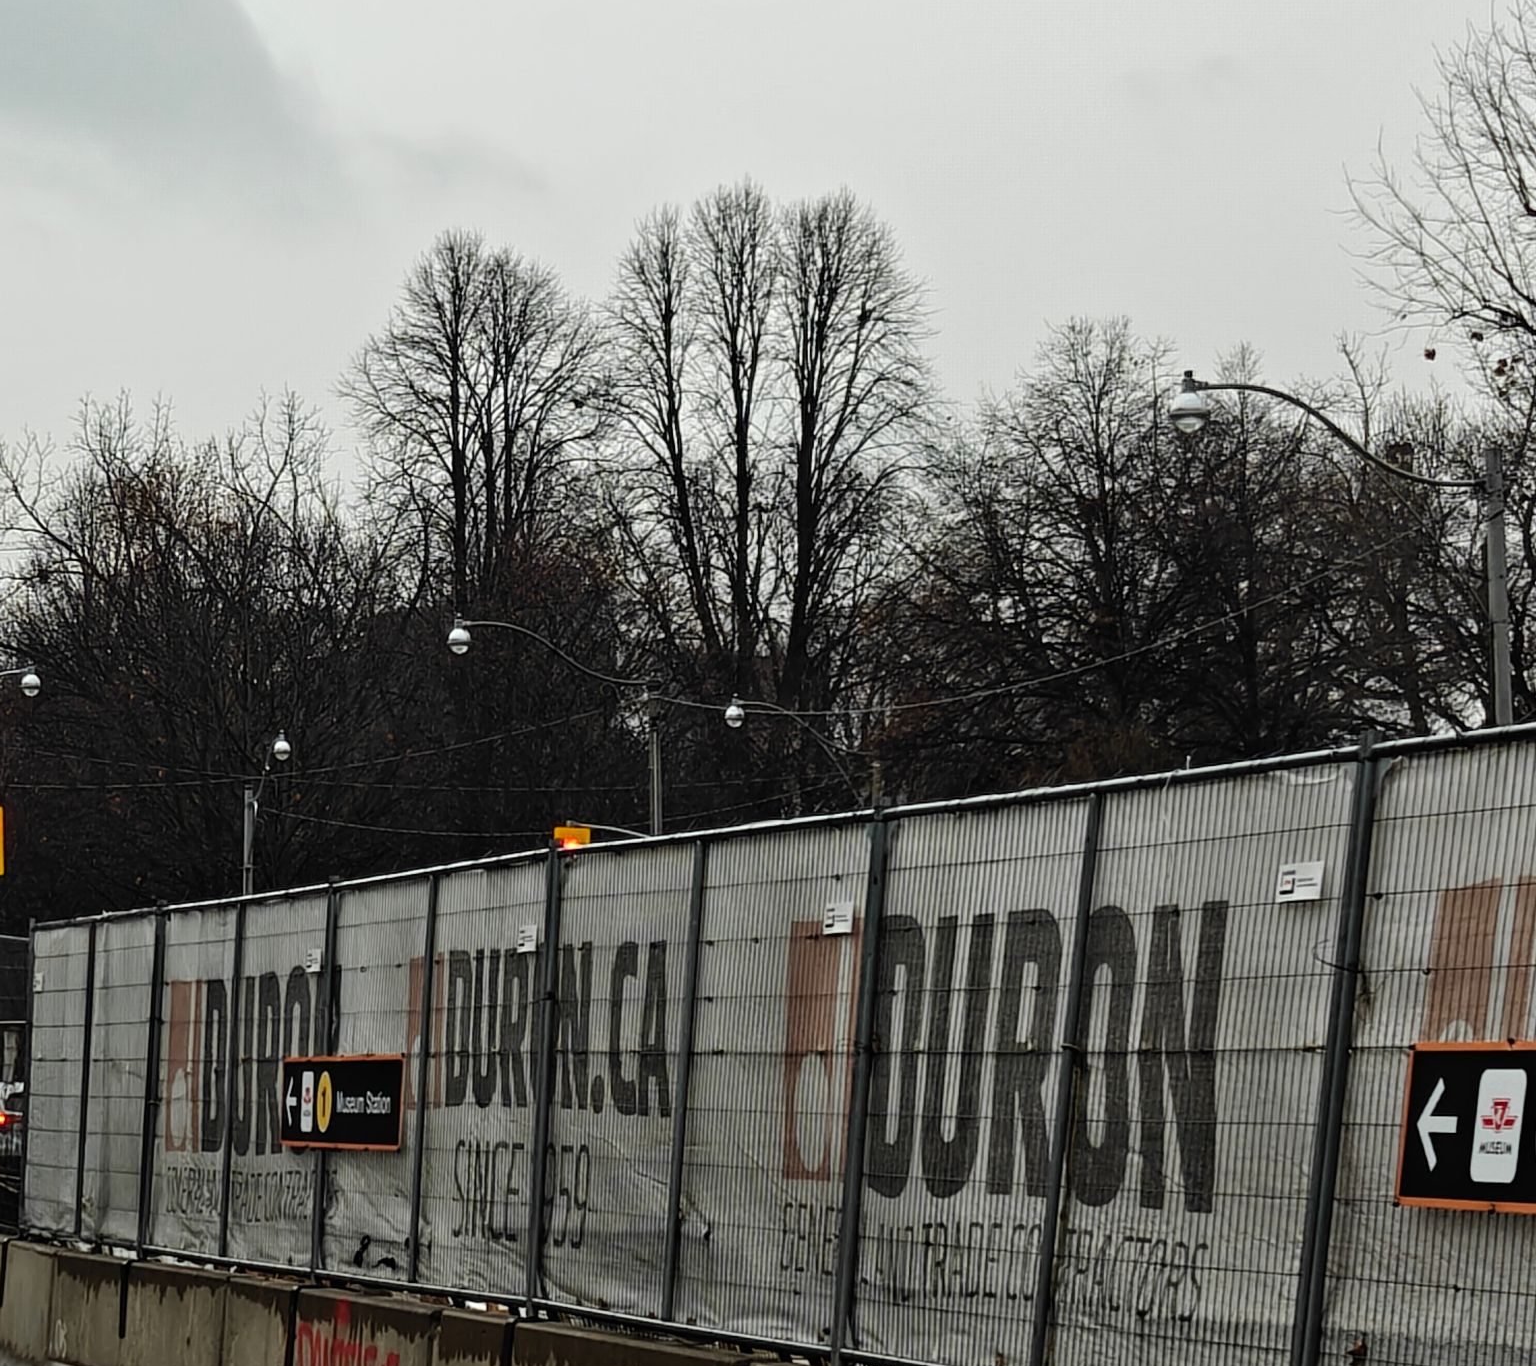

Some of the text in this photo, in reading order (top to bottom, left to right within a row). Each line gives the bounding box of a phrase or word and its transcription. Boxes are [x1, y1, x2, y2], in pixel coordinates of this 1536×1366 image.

[321, 1085, 328, 1118] 1
[335, 1090, 392, 1115] Museum Station
[865, 900, 1229, 1215] DURON
[453, 1139, 591, 1250] SINCE 959
[1007, 1222, 1210, 1326] COTRACTORS
